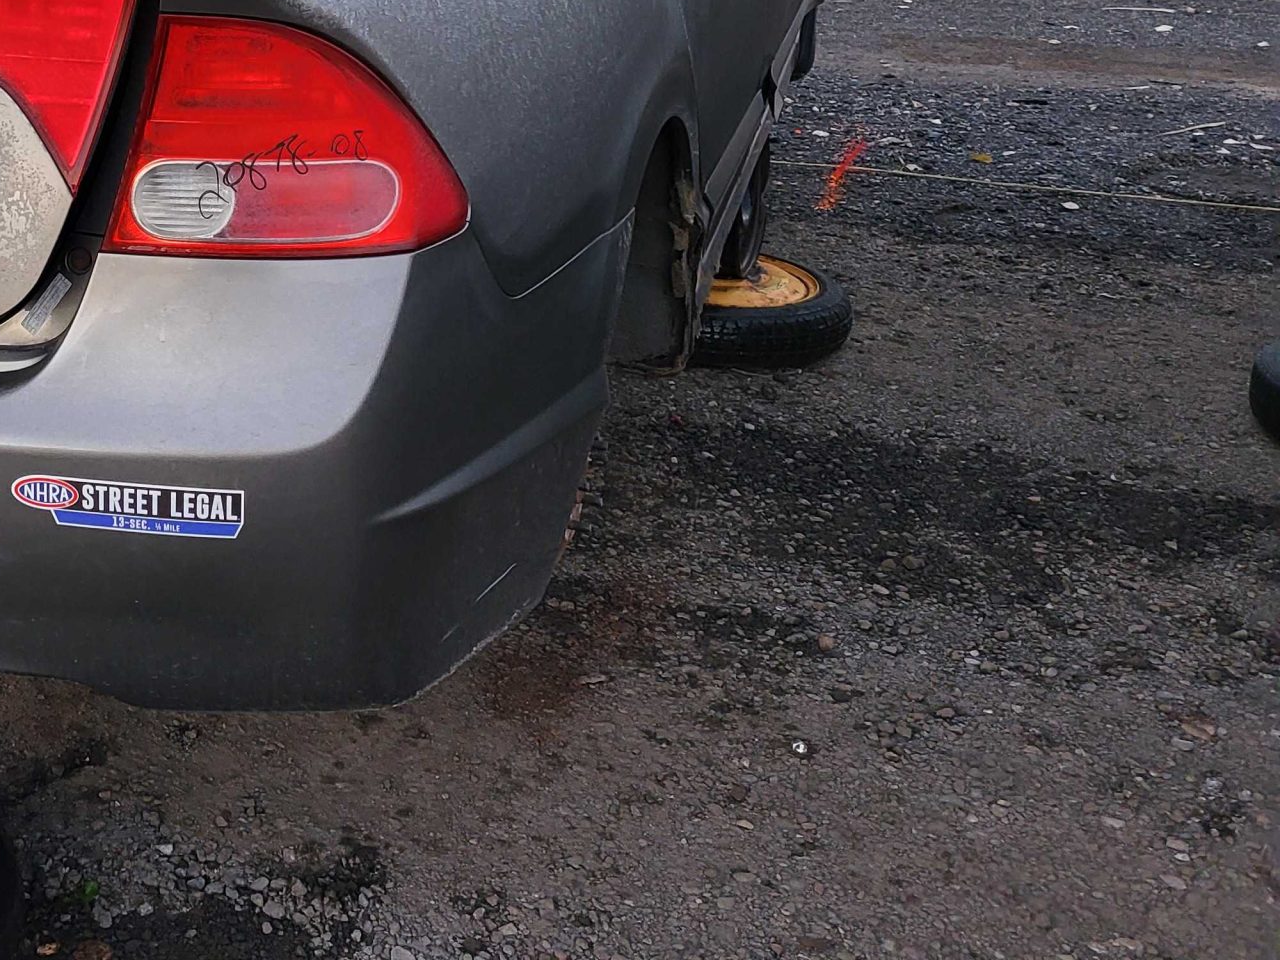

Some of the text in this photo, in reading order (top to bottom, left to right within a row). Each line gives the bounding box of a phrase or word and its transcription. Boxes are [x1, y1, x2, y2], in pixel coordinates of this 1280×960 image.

[22, 482, 70, 504] NHRA
[81, 484, 239, 522] STREET LEGAL
